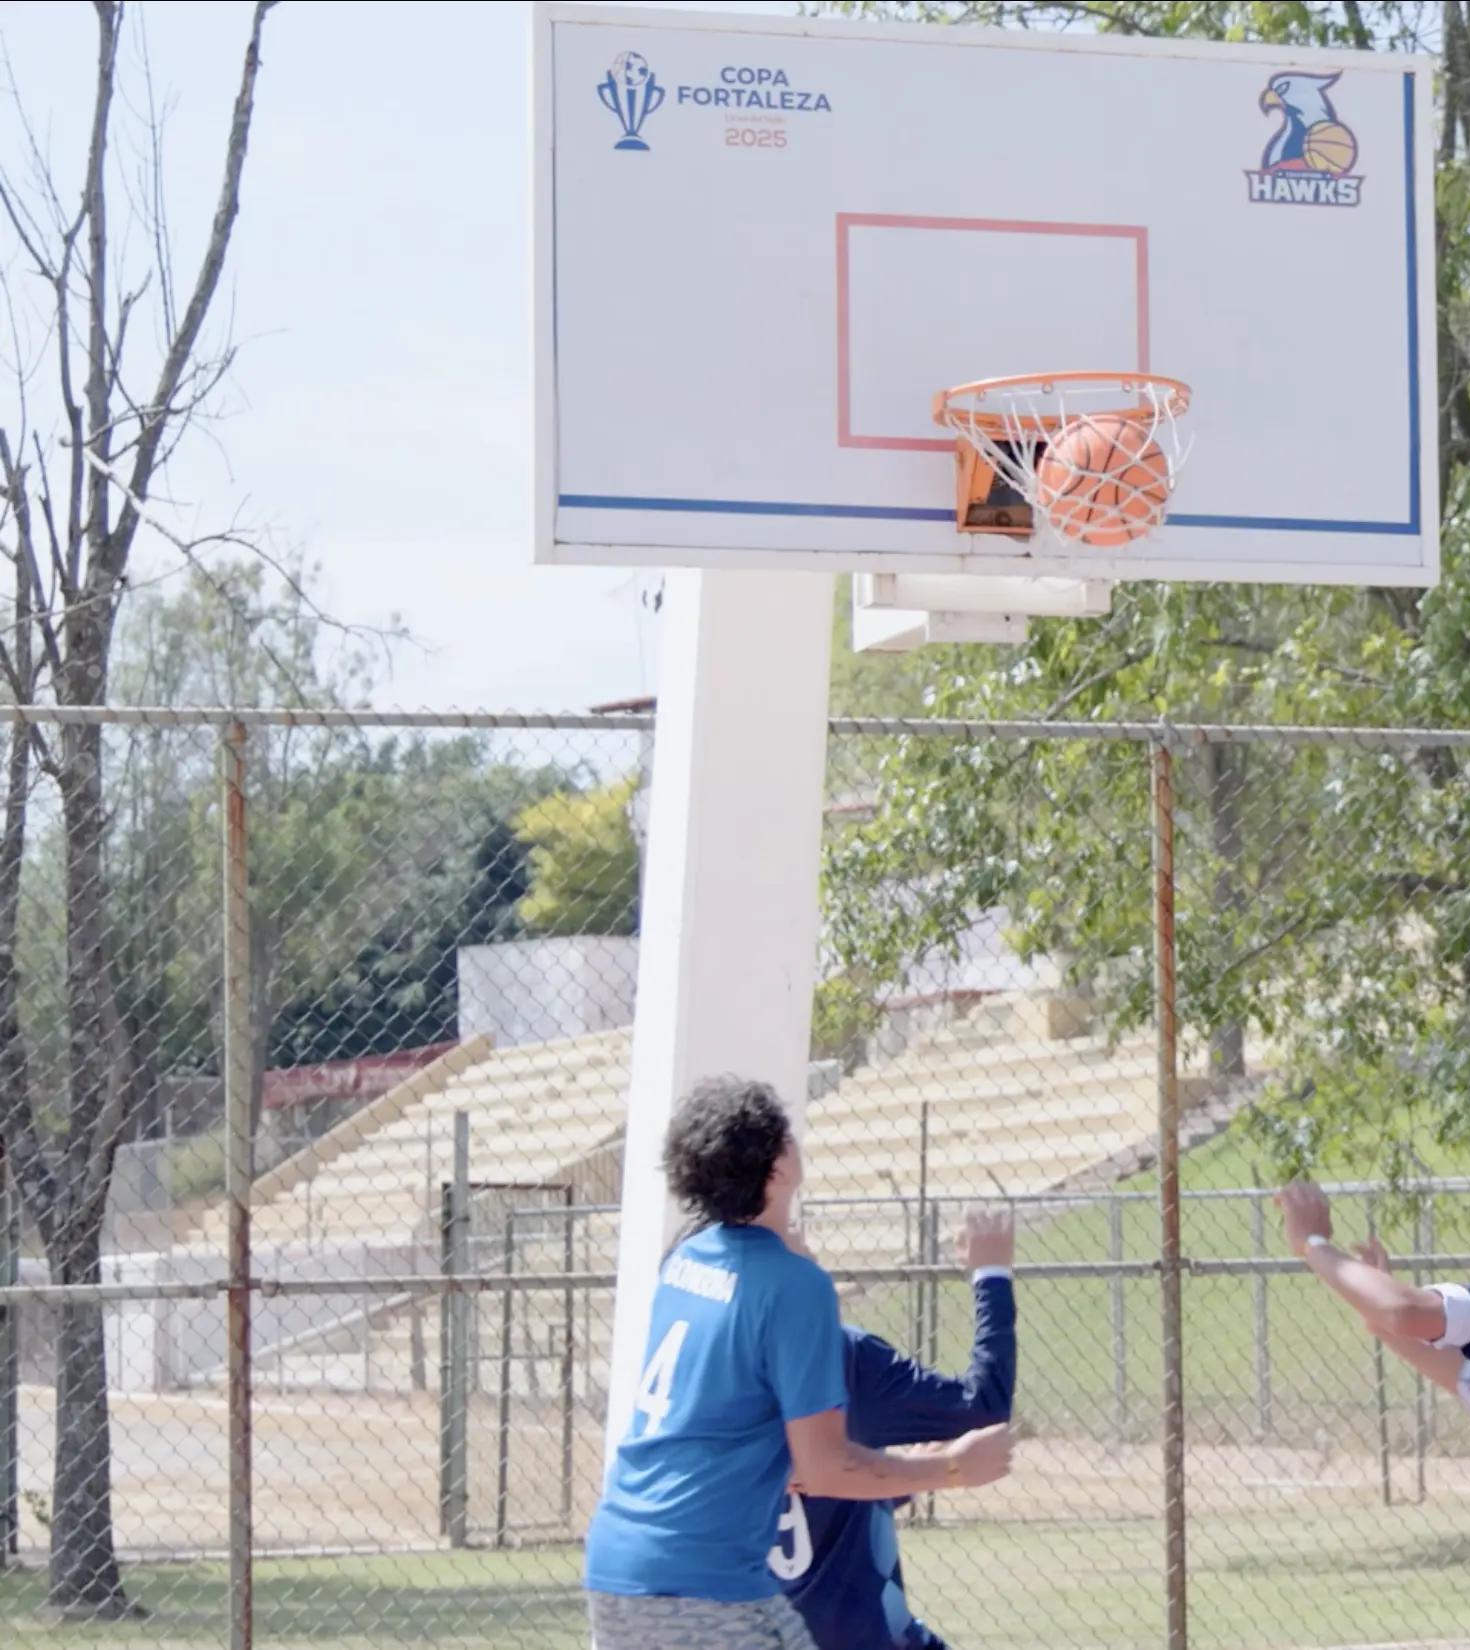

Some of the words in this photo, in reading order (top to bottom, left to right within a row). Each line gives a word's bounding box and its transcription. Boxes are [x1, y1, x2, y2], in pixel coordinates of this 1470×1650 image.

[720, 66, 789, 87] COPA
[677, 86, 832, 112] FORTALEZA
[725, 128, 788, 148] 2025
[1251, 174, 1358, 204] HAWKS
[635, 1320, 690, 1438] 4
